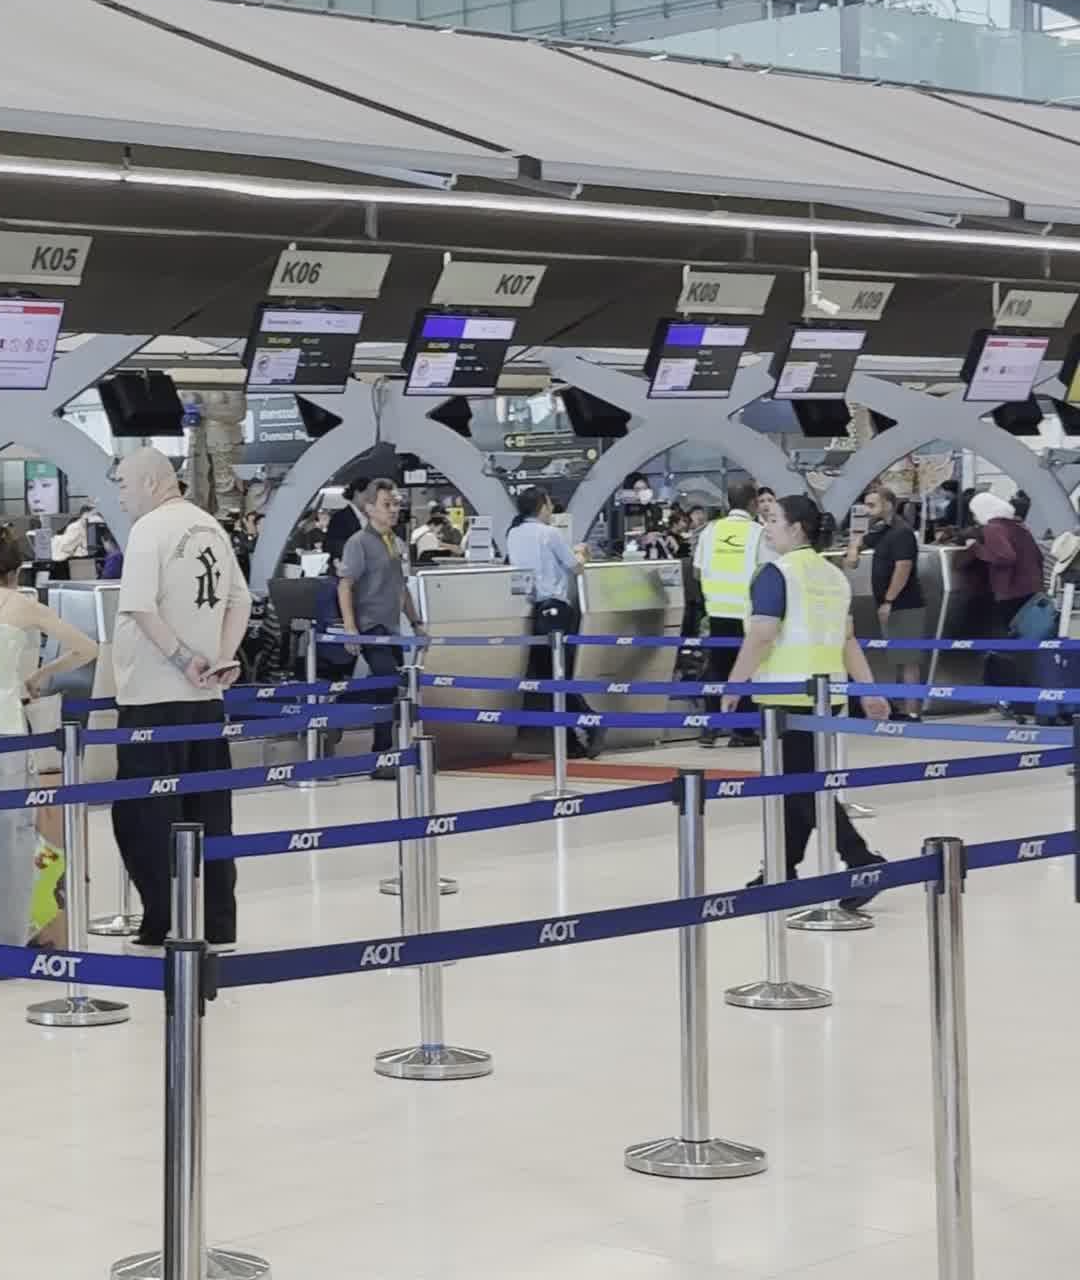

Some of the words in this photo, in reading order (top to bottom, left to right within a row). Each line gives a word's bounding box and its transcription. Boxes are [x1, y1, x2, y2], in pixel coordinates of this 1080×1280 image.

[31, 245, 80, 271] K05
[280, 261, 322, 284] K06
[495, 274, 535, 295] K07
[686, 282, 721, 302] K08
[852, 291, 884, 310] K09
[868, 639, 890, 647] AOT
[952, 640, 974, 649] AOT
[1039, 640, 1062, 649] AOT
[257, 687, 276, 698] AOT
[329, 681, 348, 692] AOT
[433, 676, 456, 686] AOT
[519, 680, 540, 691] AOT
[608, 683, 630, 694] AOT
[702, 683, 726, 694] AOT
[929, 687, 955, 697] AOT
[1038, 690, 1067, 701] AOT
[281, 704, 302, 715] AOT
[477, 711, 502, 722] AOT
[577, 715, 603, 726] AOT
[683, 715, 709, 726] AOT
[130, 729, 154, 742] AOT
[222, 724, 244, 736] AOT
[307, 717, 328, 728] AOT
[875, 723, 907, 735] AOT
[1007, 730, 1040, 742] AOT
[26, 790, 58, 805] AOT
[150, 778, 180, 794] AOT
[267, 765, 294, 781] AOT
[376, 752, 401, 767] AOT
[717, 781, 745, 796] AOT
[824, 773, 849, 787] AOT
[924, 763, 949, 777] AOT
[1019, 754, 1043, 767] AOT
[288, 832, 322, 849] AOT
[426, 817, 458, 834] AOT
[553, 799, 584, 816] AOT
[1019, 840, 1046, 858] AOT
[360, 942, 405, 966] AOT
[539, 920, 580, 943] AOT
[702, 896, 738, 917] AOT
[30, 954, 83, 977] AOT
